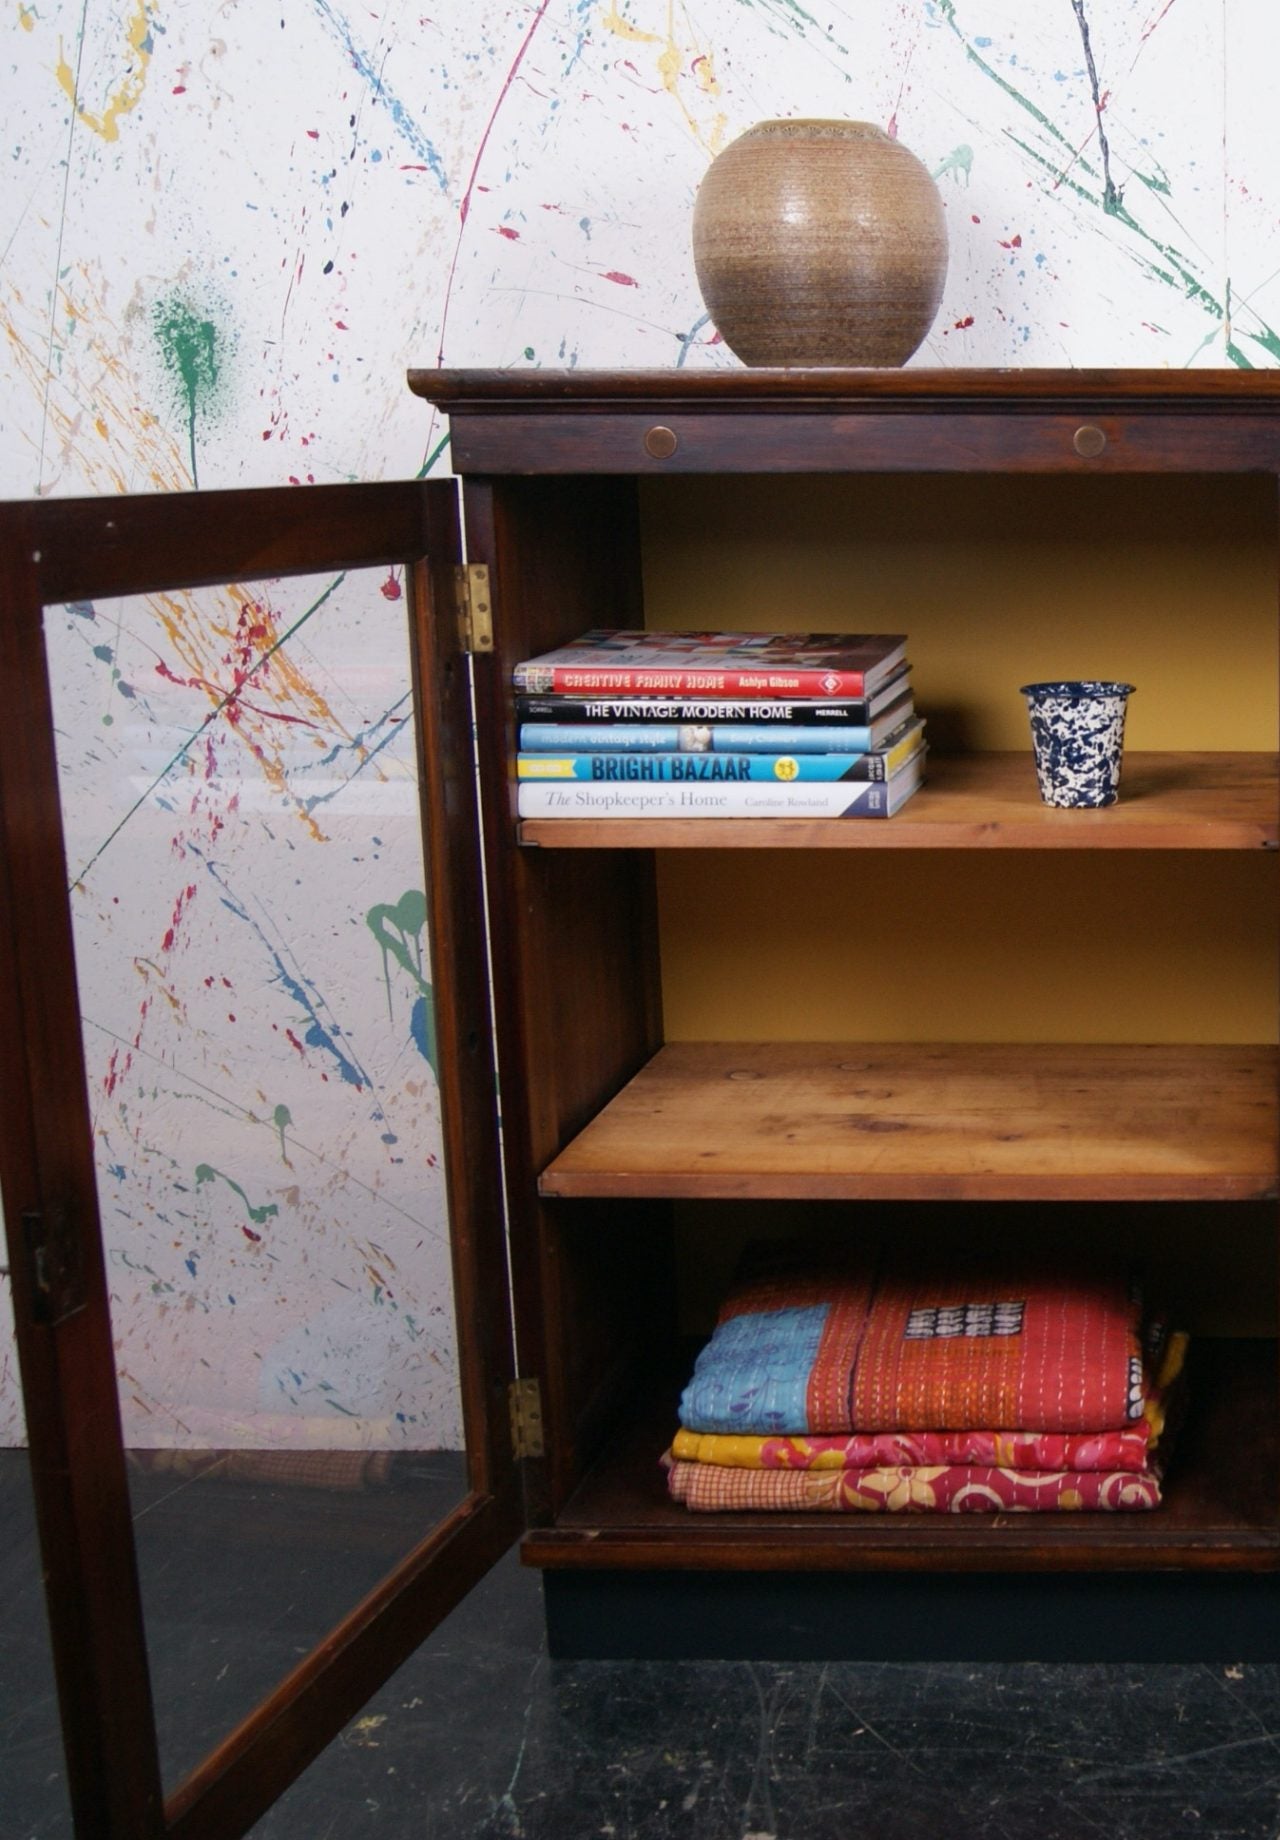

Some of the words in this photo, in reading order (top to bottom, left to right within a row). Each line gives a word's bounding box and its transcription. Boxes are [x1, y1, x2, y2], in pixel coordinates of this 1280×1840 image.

[563, 674, 630, 688] CREATIVE
[636, 674, 682, 688] FAMILY
[686, 674, 725, 689] HOME
[739, 677, 767, 689] Ashlyn
[769, 677, 799, 688] Gibson
[584, 704, 610, 717] THE
[611, 704, 678, 718] VINTAGE
[682, 705, 745, 718] MODERN
[750, 705, 792, 719] HOME
[815, 709, 848, 717] MERRELL
[640, 732, 666, 747] style
[592, 757, 667, 781] BRIGHT
[671, 757, 750, 781] BAZAAR
[545, 792, 572, 806] The
[575, 792, 676, 810] Shopkeeper's
[680, 792, 728, 806] Home
[745, 796, 782, 807] Caroline
[787, 796, 829, 807] Rowland
